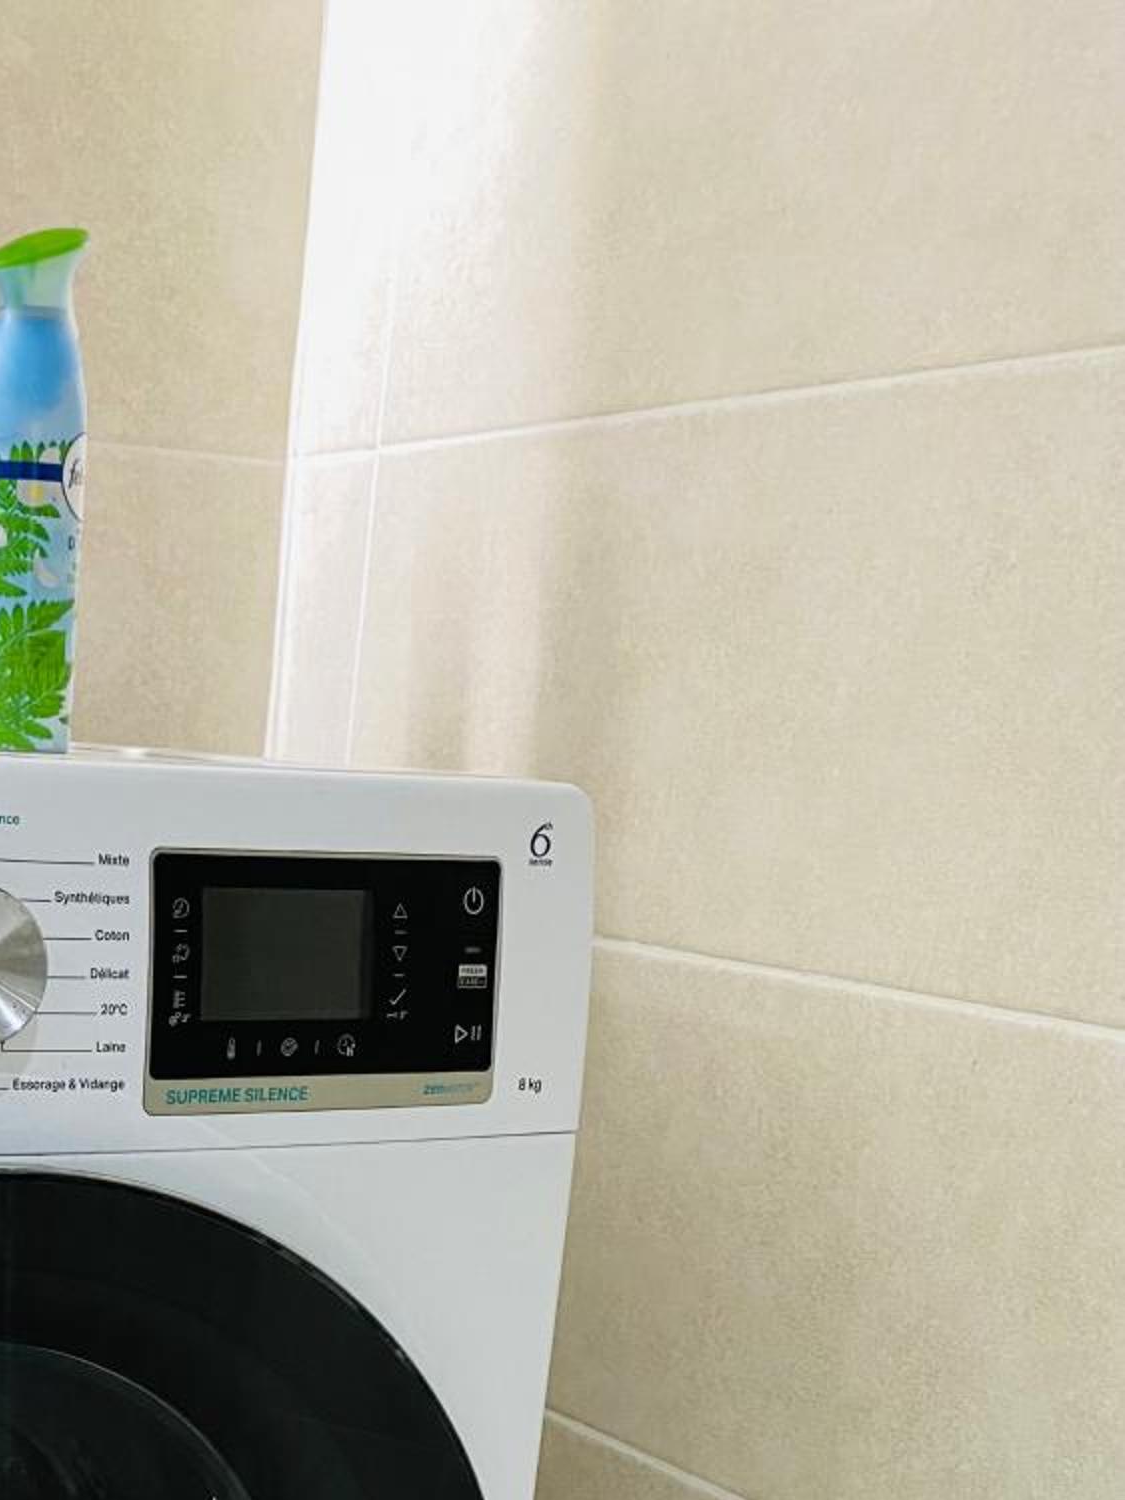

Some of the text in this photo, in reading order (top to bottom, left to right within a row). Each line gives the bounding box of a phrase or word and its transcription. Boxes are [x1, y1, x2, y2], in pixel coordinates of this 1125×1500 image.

[98, 853, 130, 866] Mixte
[95, 929, 130, 942] Coton
[100, 1003, 128, 1016] 20°C
[96, 1041, 126, 1053] Laine
[12, 1078, 125, 1093] Essorage & Vidange
[518, 1078, 542, 1094] 8 kg
[166, 1083, 308, 1105] SUPREME SILENCE
